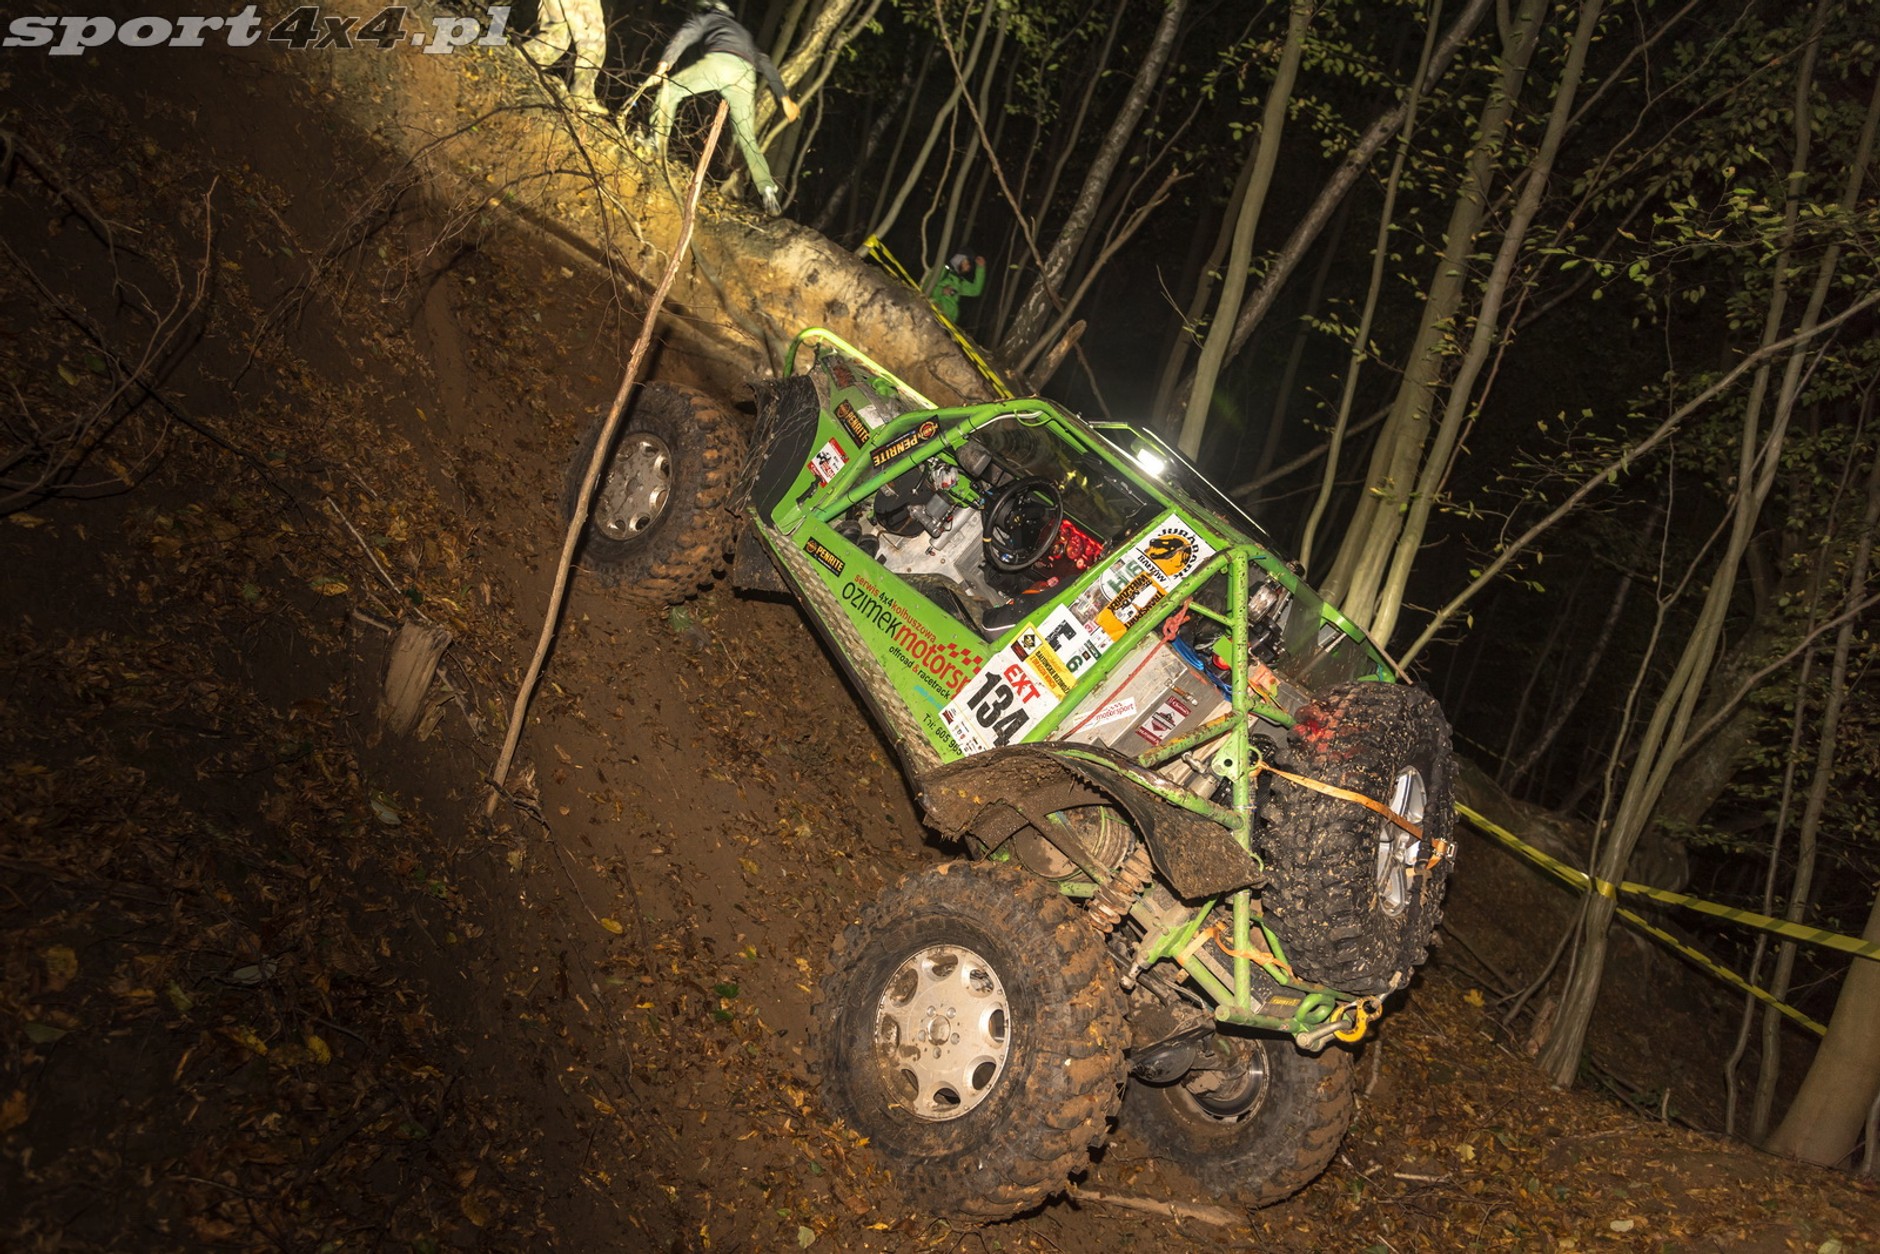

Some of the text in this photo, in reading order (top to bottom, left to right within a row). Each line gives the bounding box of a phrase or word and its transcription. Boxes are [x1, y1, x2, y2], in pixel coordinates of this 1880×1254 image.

[843, 410, 870, 443] PENRITE
[872, 433, 918, 467] PENRITE
[814, 545, 844, 572] PENRITE
[853, 574, 881, 598] serwis
[1122, 589, 1165, 631] TRANSPORT
[887, 645, 914, 669] offroad
[911, 663, 920, 673] &
[916, 669, 951, 700] racetrack
[1002, 662, 1041, 704] EXT
[966, 671, 1030, 747] 134
[934, 725, 951, 743] 605
